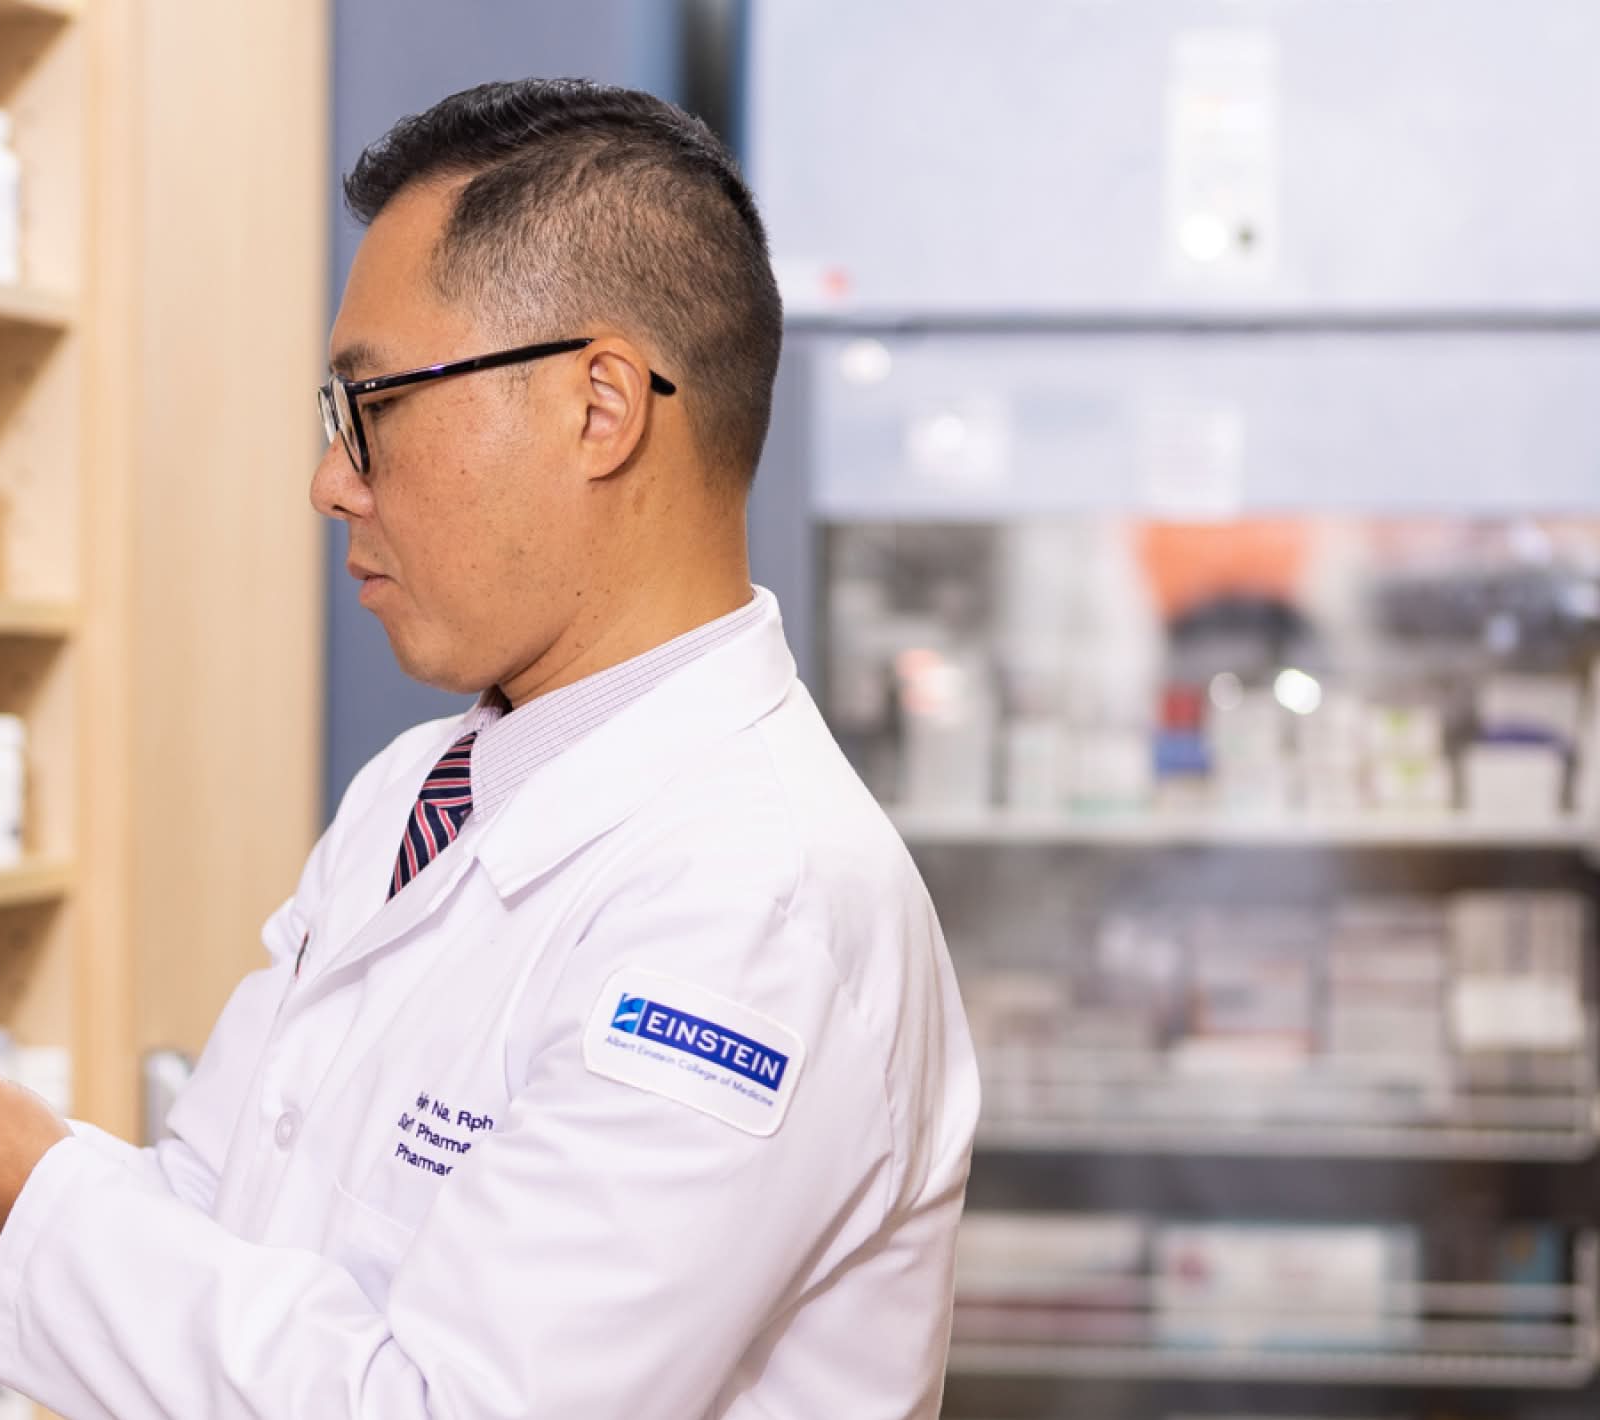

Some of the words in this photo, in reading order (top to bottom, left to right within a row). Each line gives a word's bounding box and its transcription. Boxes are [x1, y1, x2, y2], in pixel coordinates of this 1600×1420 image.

[605, 1034, 636, 1052] Albert
[637, 1042, 676, 1064] Einstein
[679, 1060, 718, 1081] College
[733, 1080, 774, 1107] Medicine
[646, 1011, 780, 1081] EINSTEIN
[457, 1110, 494, 1132] Rph
